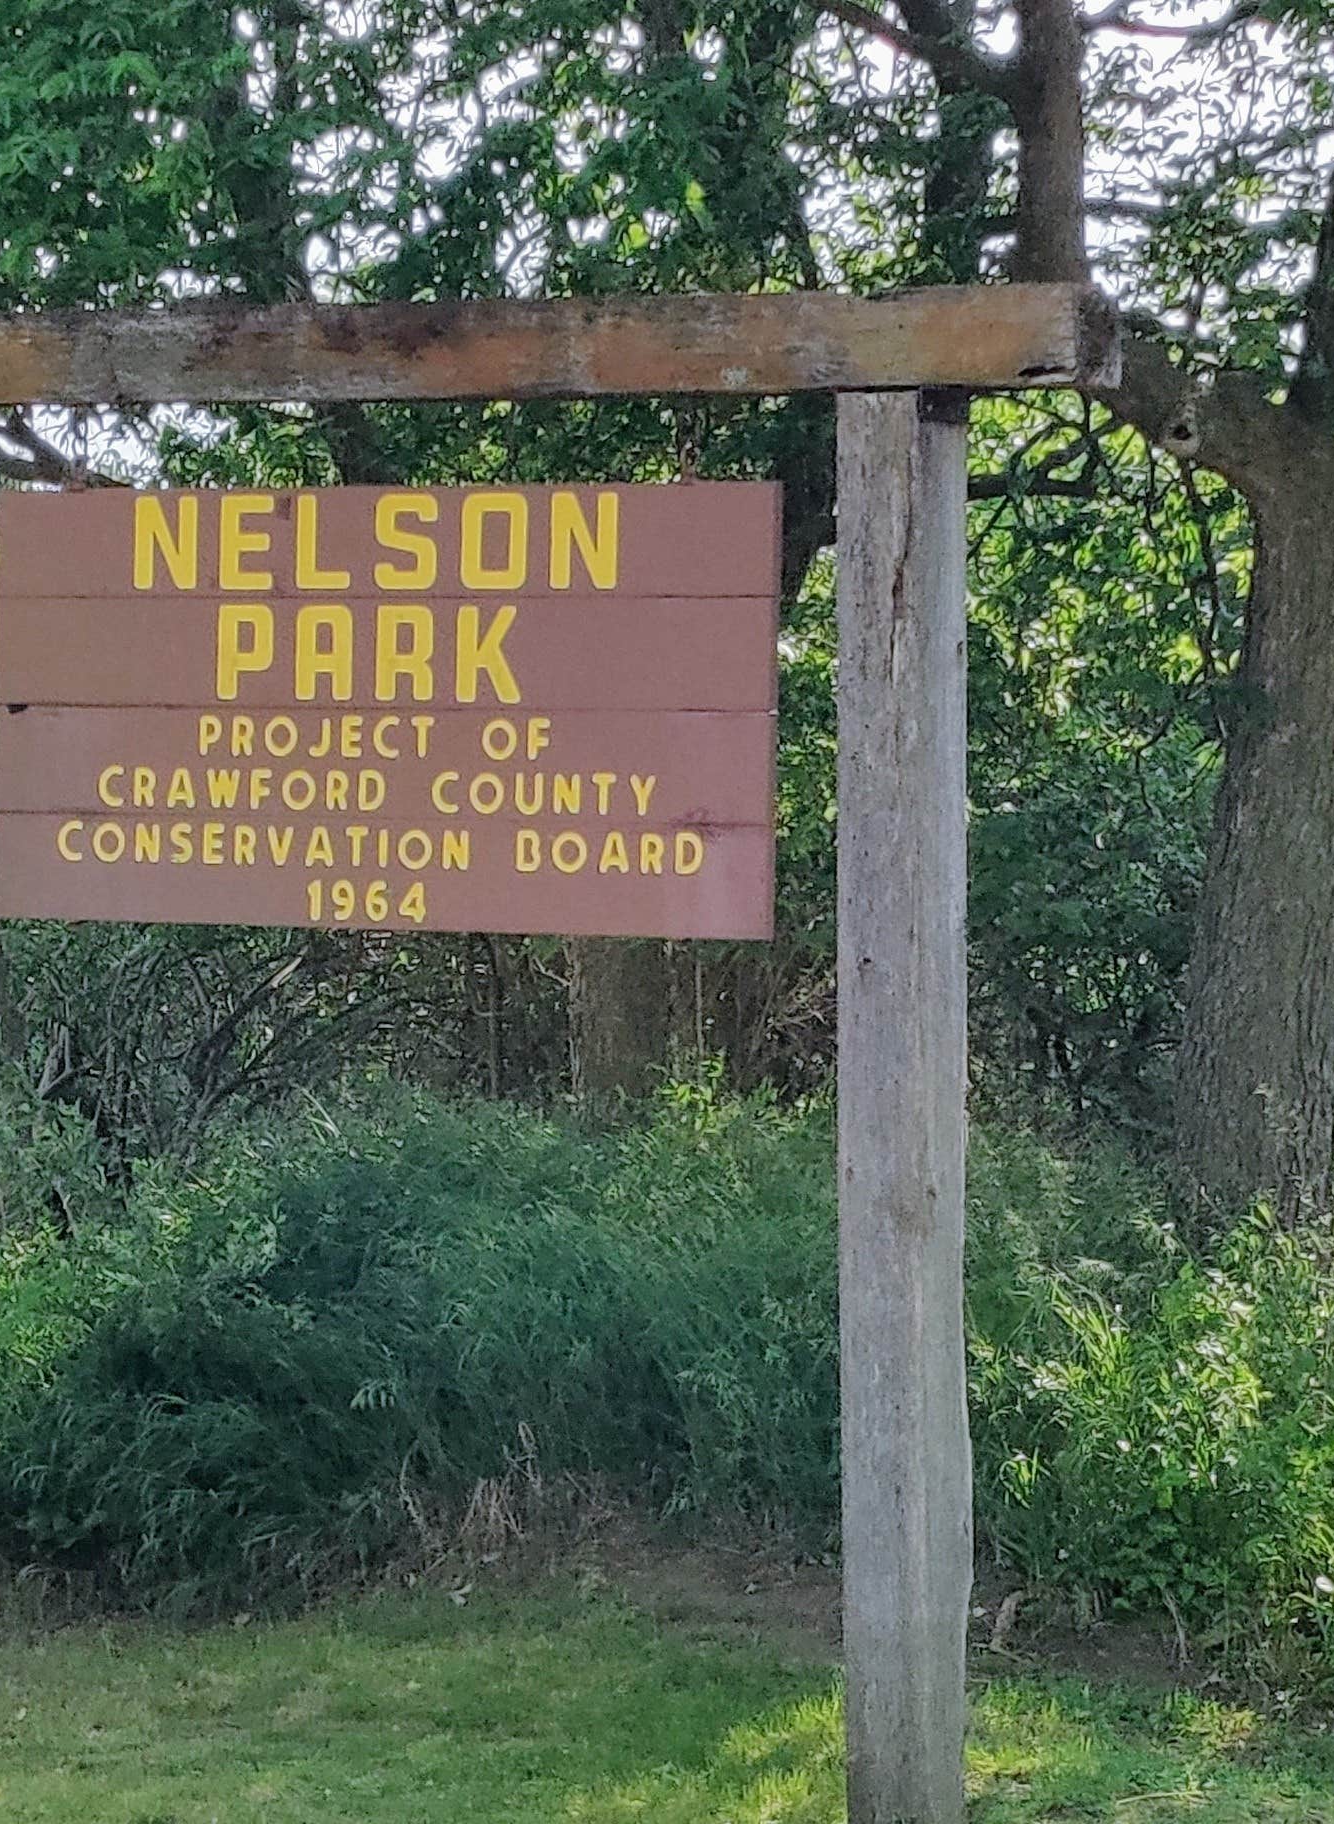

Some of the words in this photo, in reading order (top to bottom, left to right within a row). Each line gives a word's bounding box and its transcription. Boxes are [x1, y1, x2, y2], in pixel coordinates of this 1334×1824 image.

[133, 491, 620, 589] NELSON
[216, 604, 522, 703] PARK
[198, 714, 435, 759] PROJECT
[481, 717, 552, 761] OF
[98, 766, 387, 812] CRAWFORD
[432, 771, 658, 816] COUNTY
[56, 820, 471, 871] CONSERVATION
[516, 830, 706, 876] BOARD
[307, 879, 427, 923] 1964
